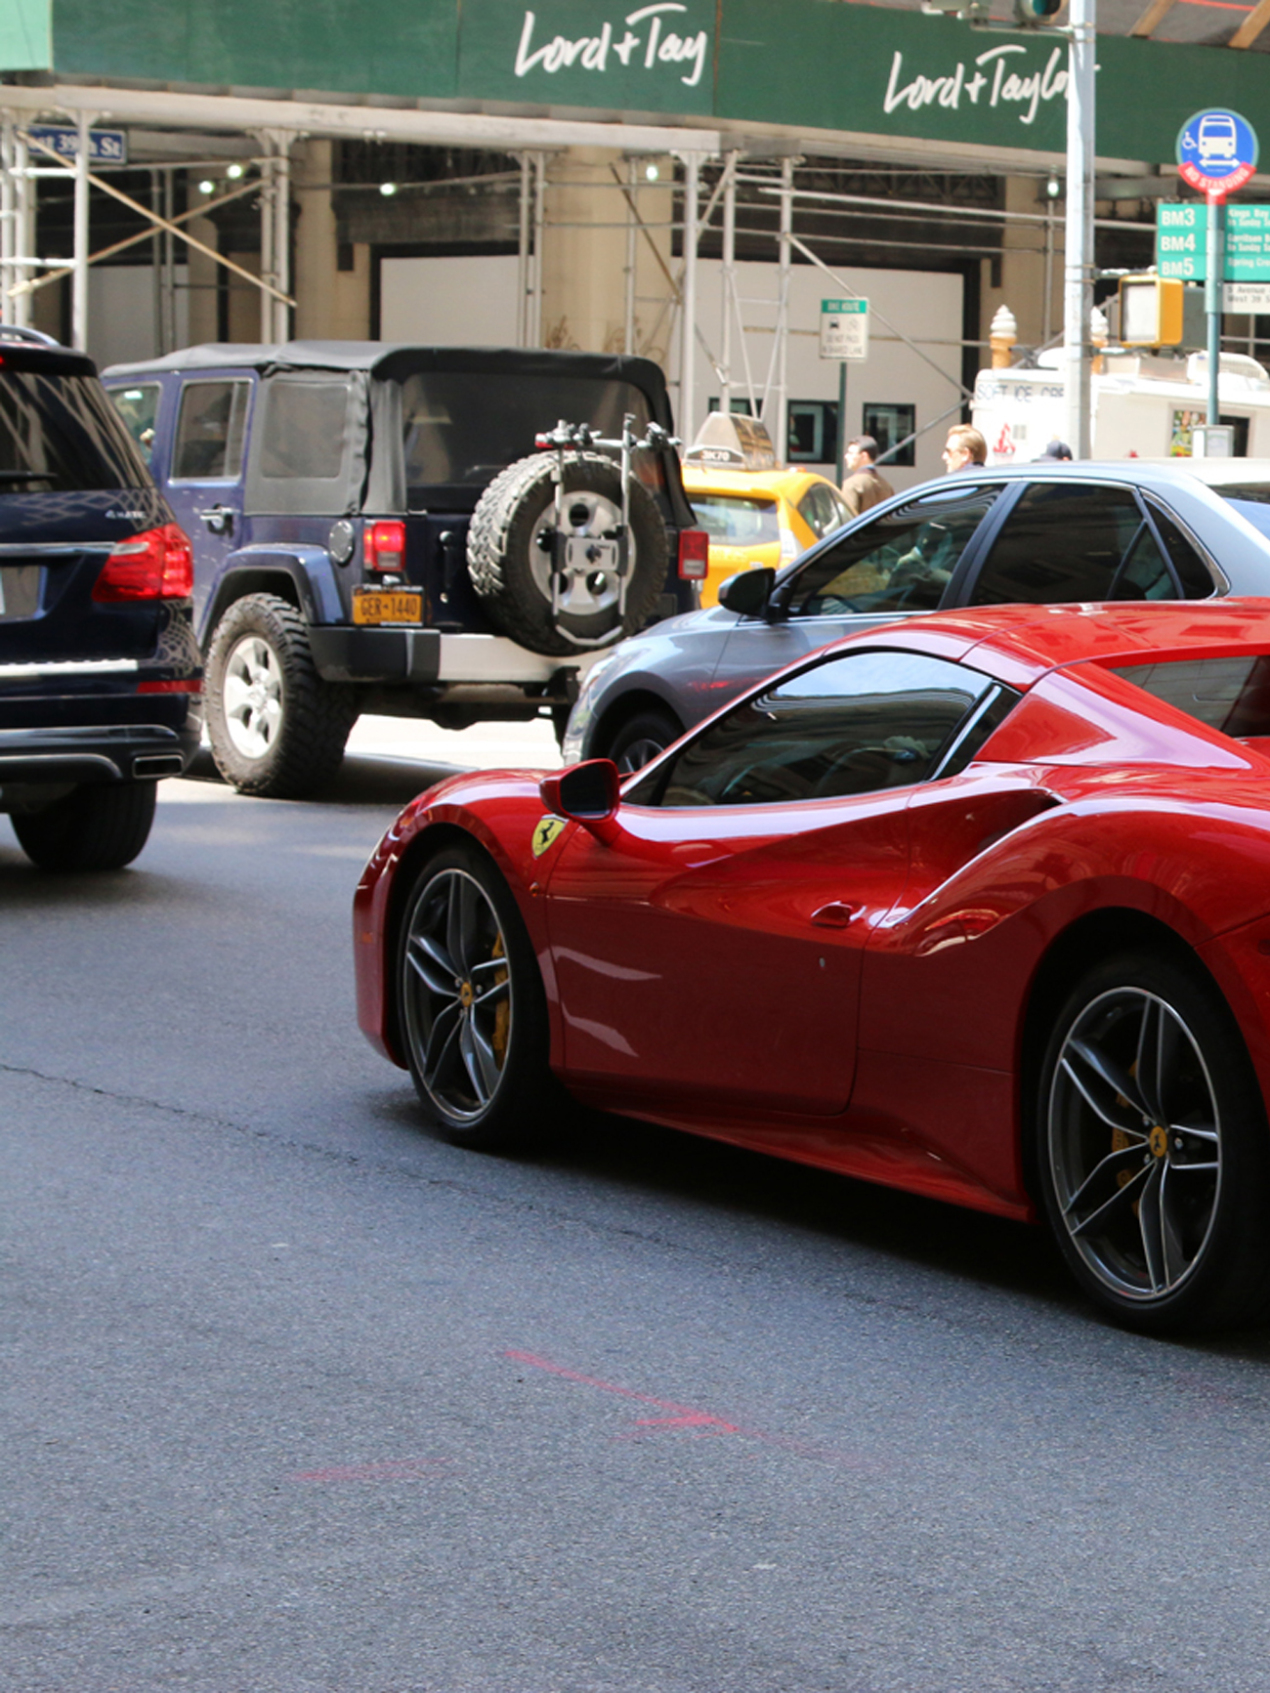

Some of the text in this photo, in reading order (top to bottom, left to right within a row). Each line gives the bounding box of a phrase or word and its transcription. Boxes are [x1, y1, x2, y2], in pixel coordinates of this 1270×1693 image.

[976, 44, 1101, 125] Taylo
[1184, 166, 1250, 188] NO STANDING
[1161, 208, 1196, 226] BM3
[1161, 233, 1196, 251] BM4
[1161, 257, 1194, 275] BM5
